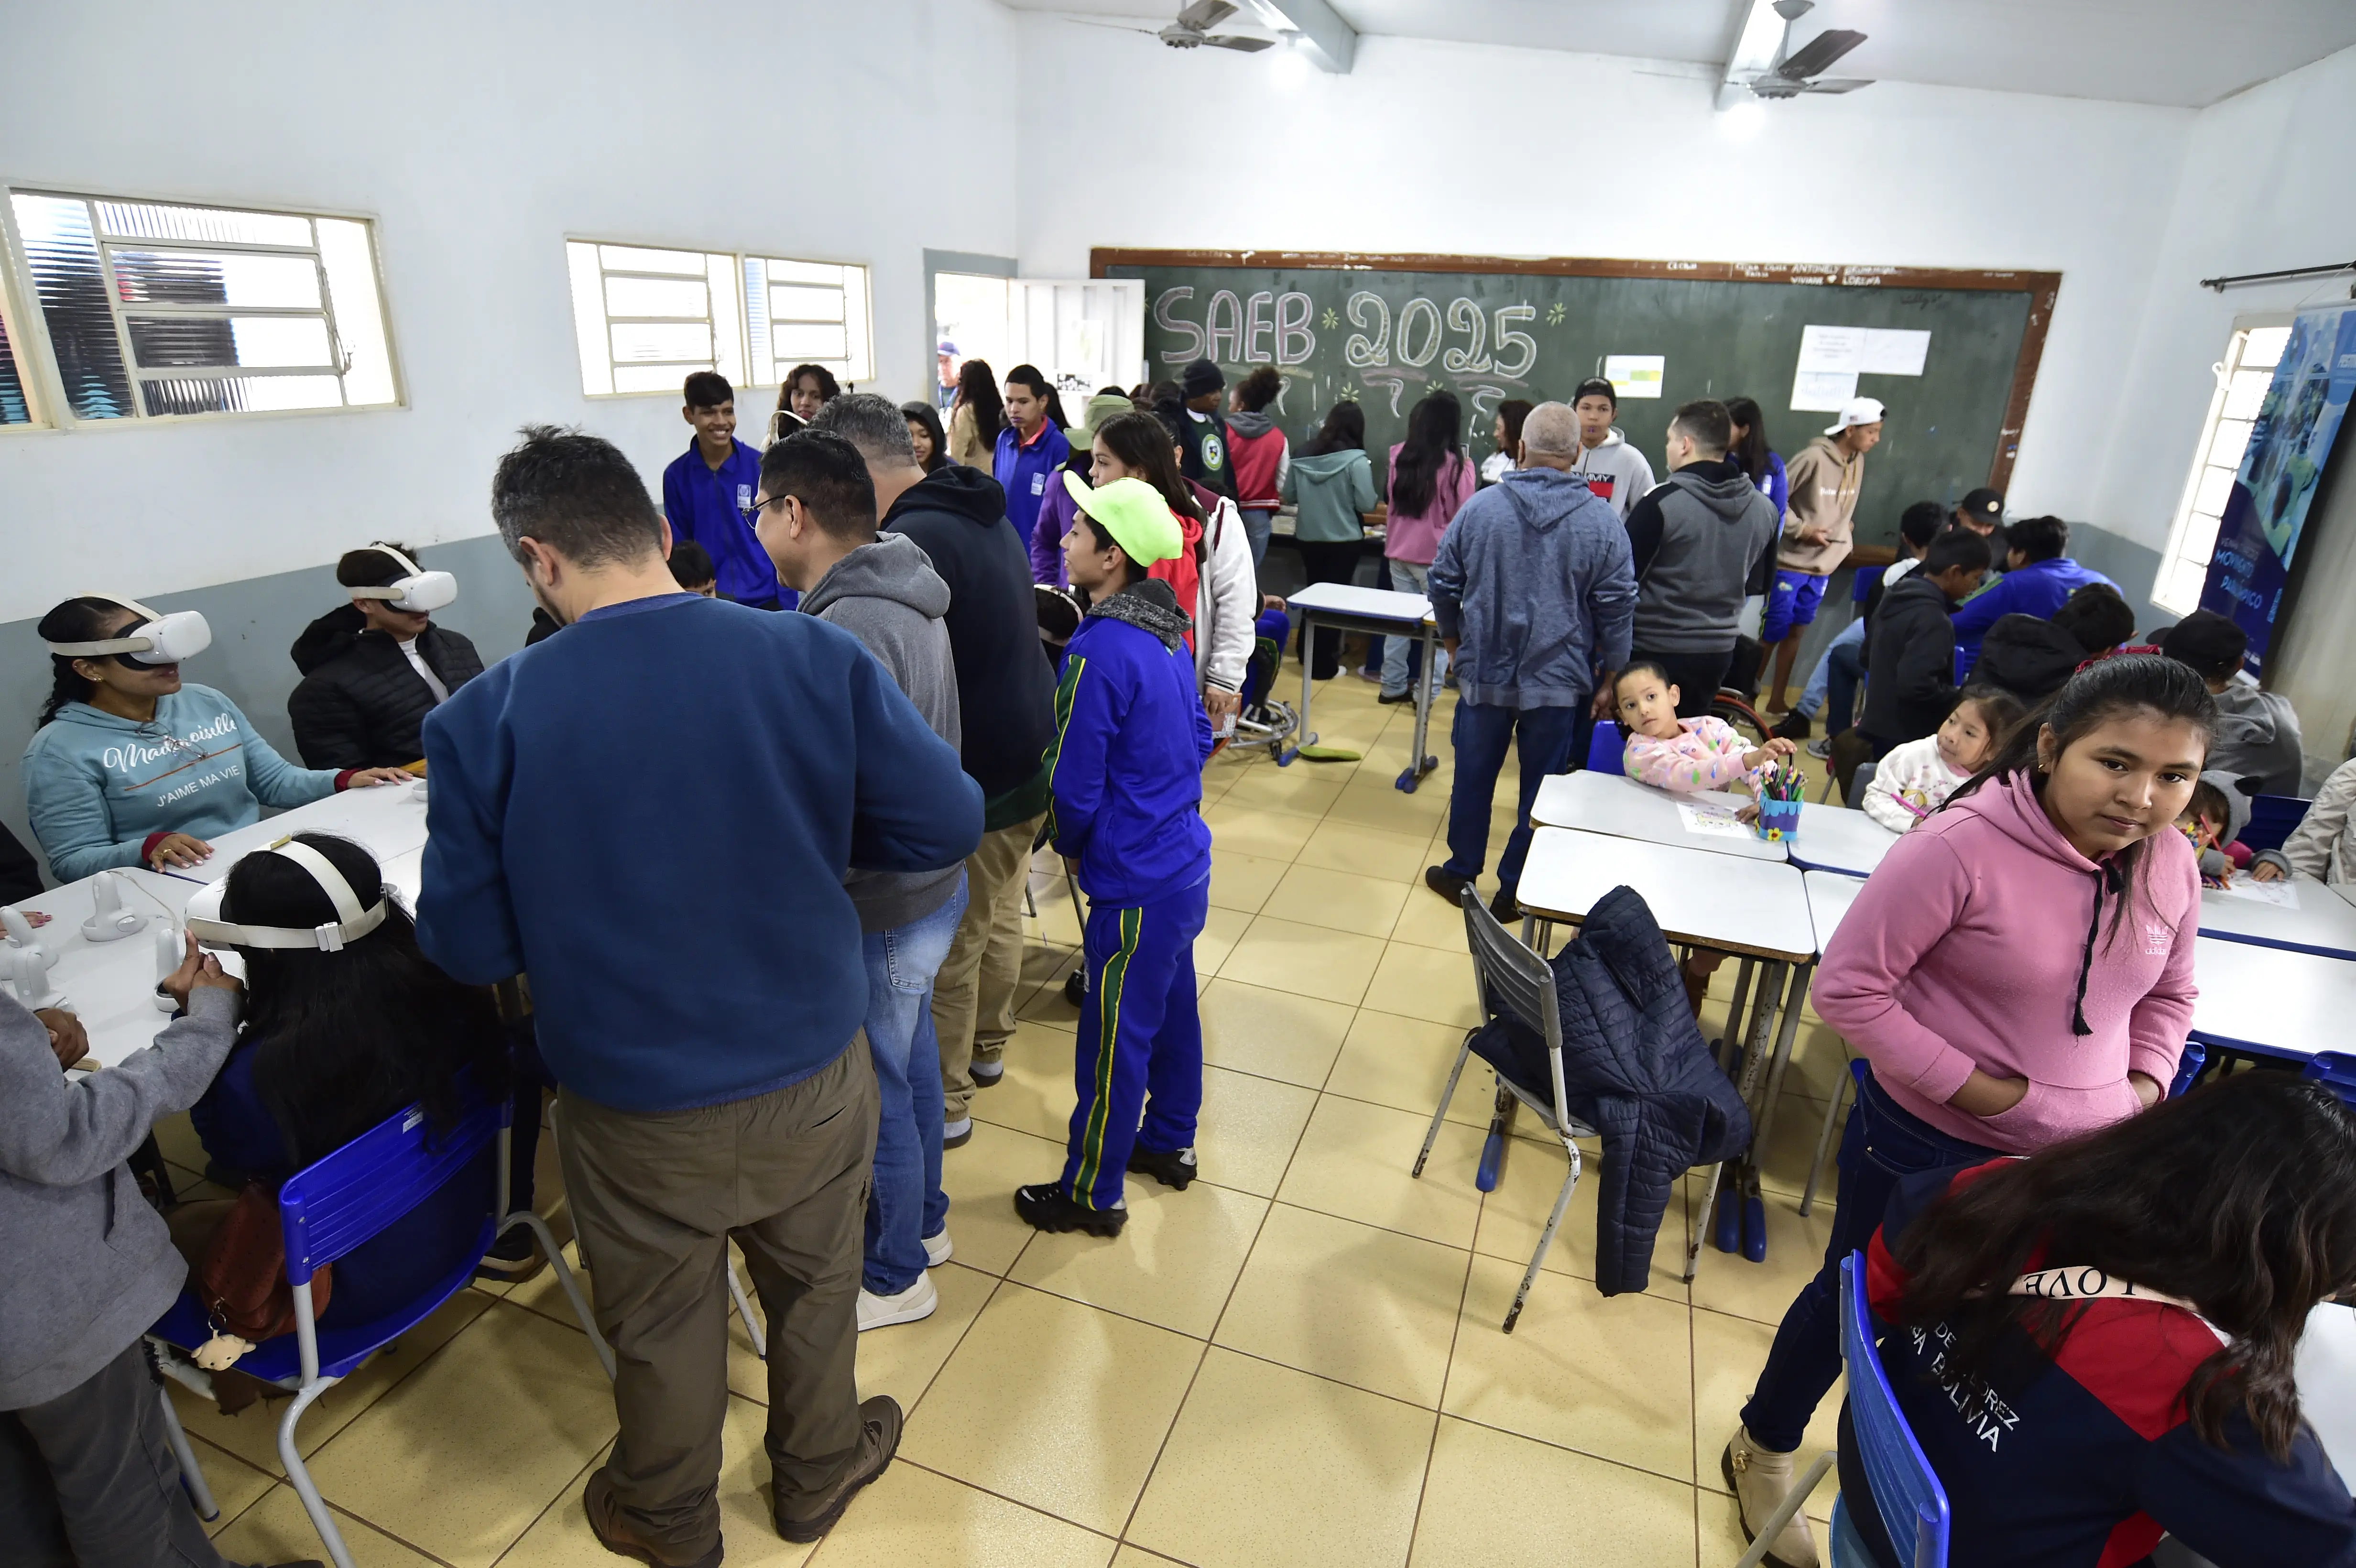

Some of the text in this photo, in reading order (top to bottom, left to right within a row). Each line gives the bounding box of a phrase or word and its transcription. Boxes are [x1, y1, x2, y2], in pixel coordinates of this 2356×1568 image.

[1154, 286, 1537, 379] SAEB 2025
[157, 765, 240, 807] J'AIME MA VIE
[1934, 1321, 1957, 1350] DE
